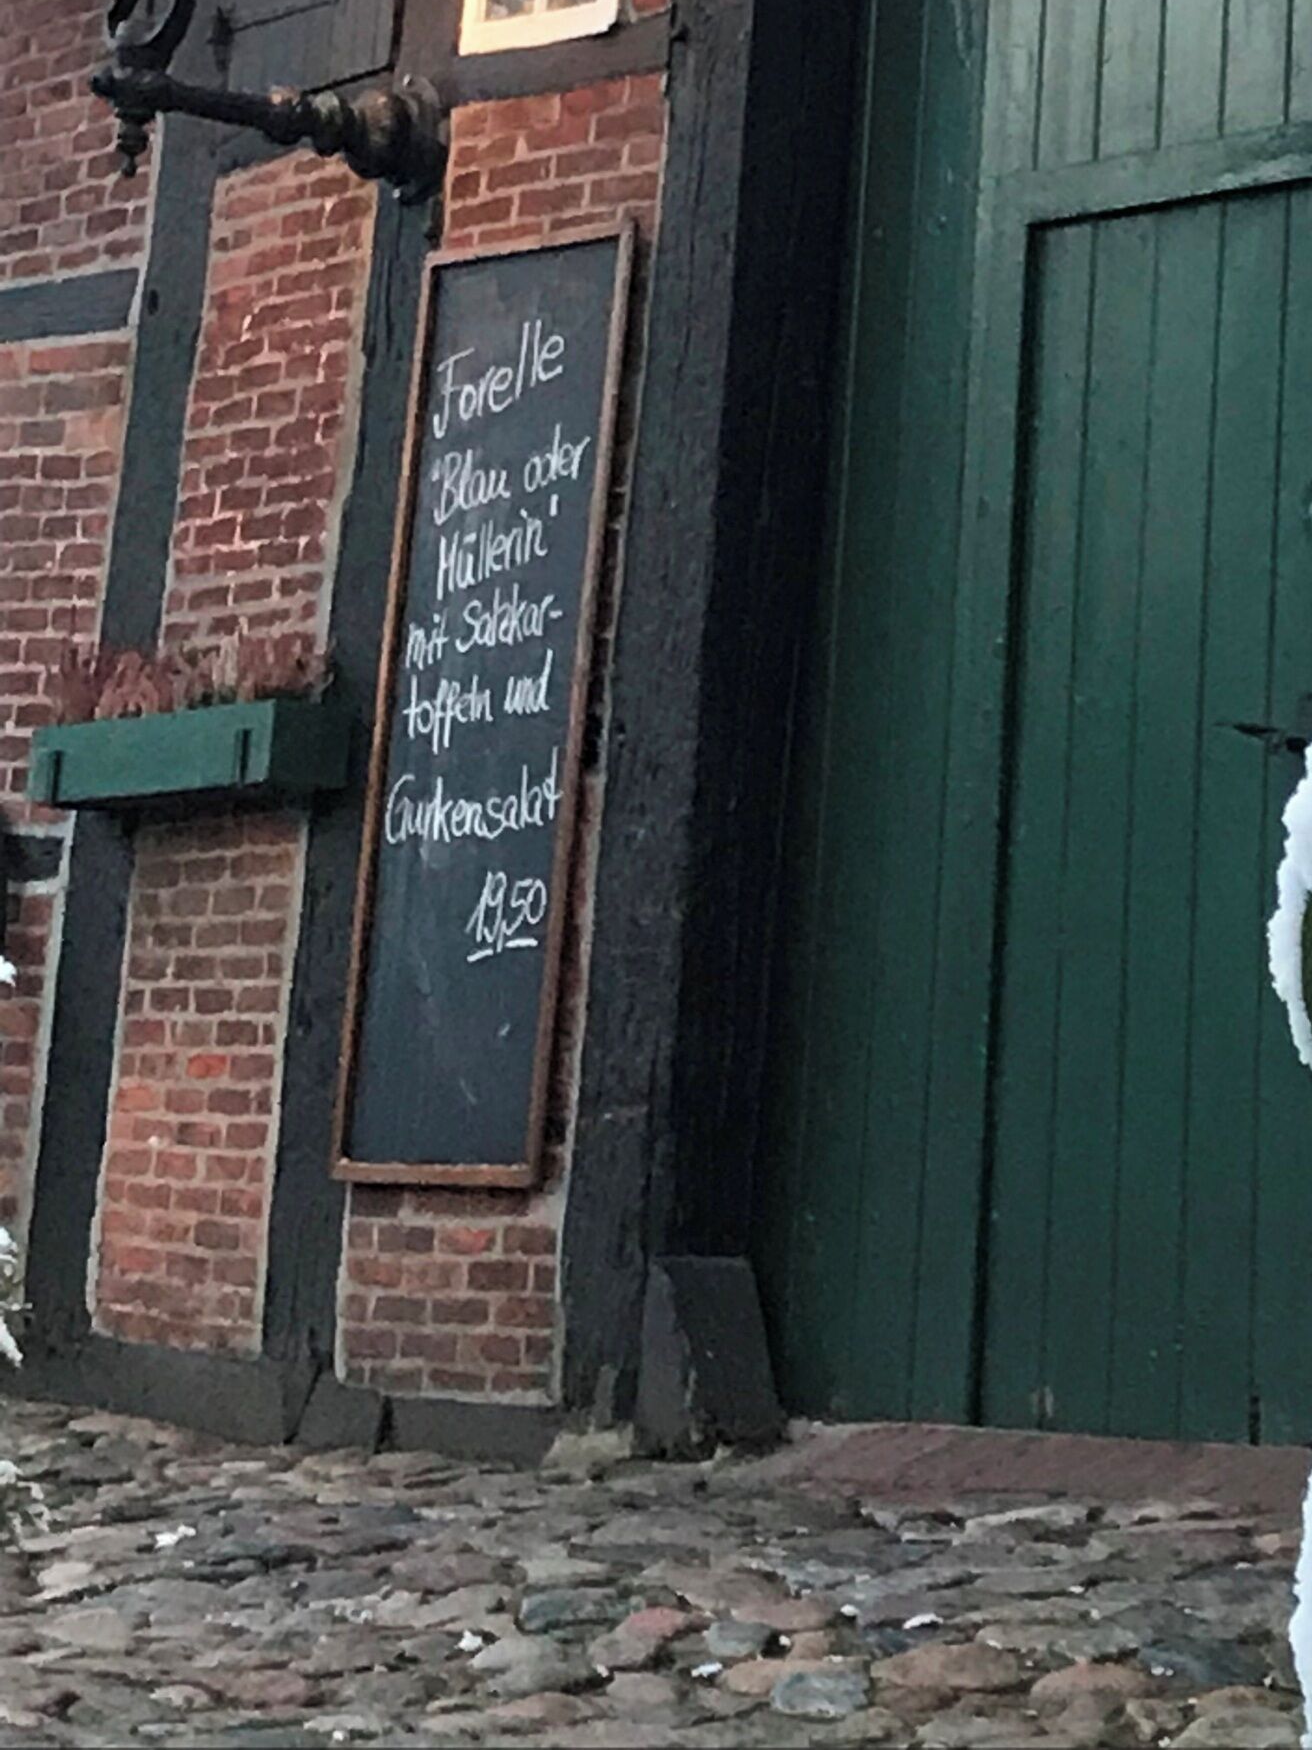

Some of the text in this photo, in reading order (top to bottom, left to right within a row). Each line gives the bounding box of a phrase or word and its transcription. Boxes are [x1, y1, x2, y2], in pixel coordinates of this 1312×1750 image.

[433, 319, 565, 439] Forelle
[524, 424, 592, 492] oder
[405, 614, 448, 670] mit
[504, 648, 554, 716] und
[385, 747, 563, 844] Gurkensalat
